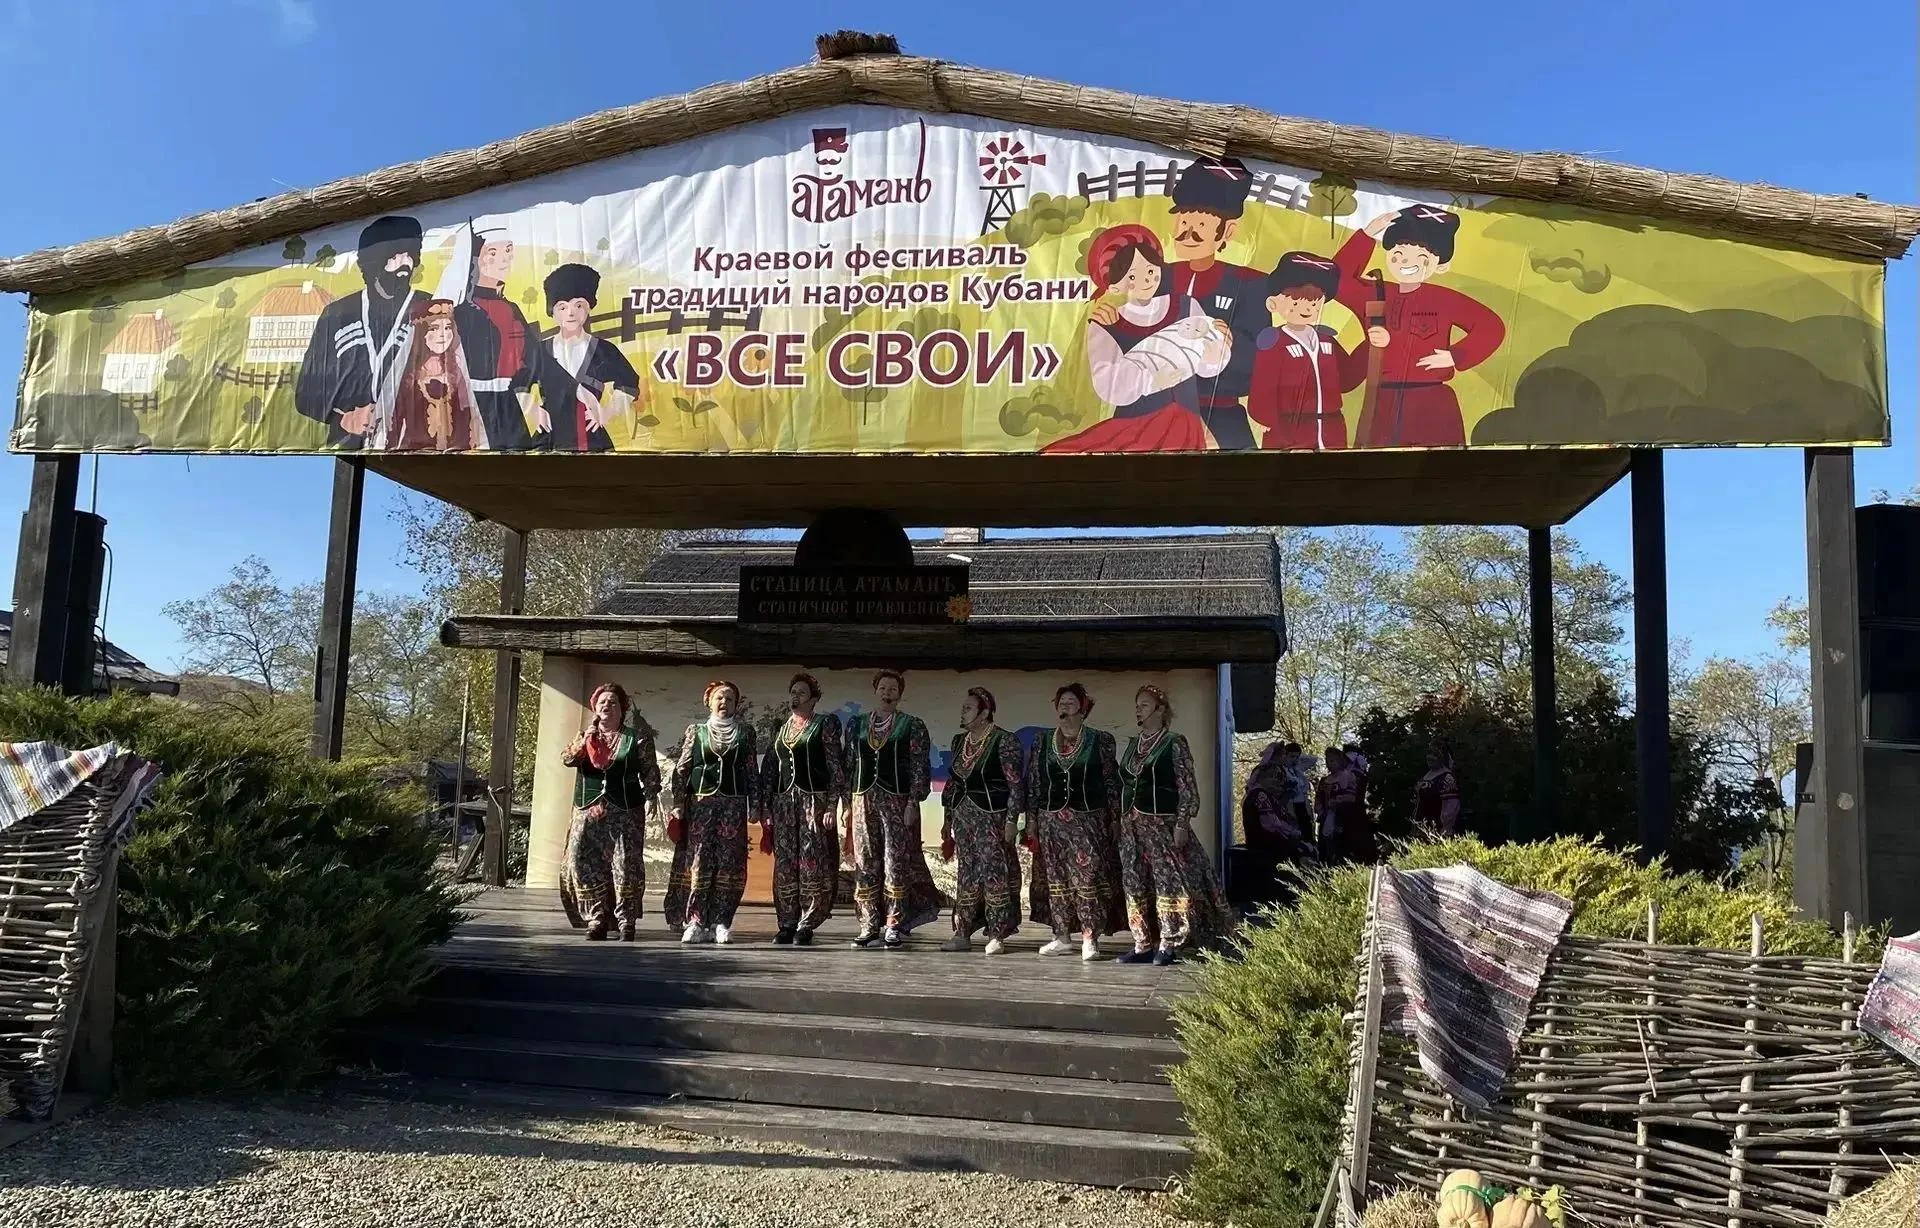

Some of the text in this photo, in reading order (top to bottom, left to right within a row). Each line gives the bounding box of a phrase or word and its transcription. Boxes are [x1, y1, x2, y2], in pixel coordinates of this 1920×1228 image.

[693, 243, 1026, 278] Краевой фестиваль
[631, 276, 1089, 312] традиций народов Кубани
[653, 331, 1060, 386] «ВСЕ СВОИ»
[750, 575, 848, 595] СТАНИЦА
